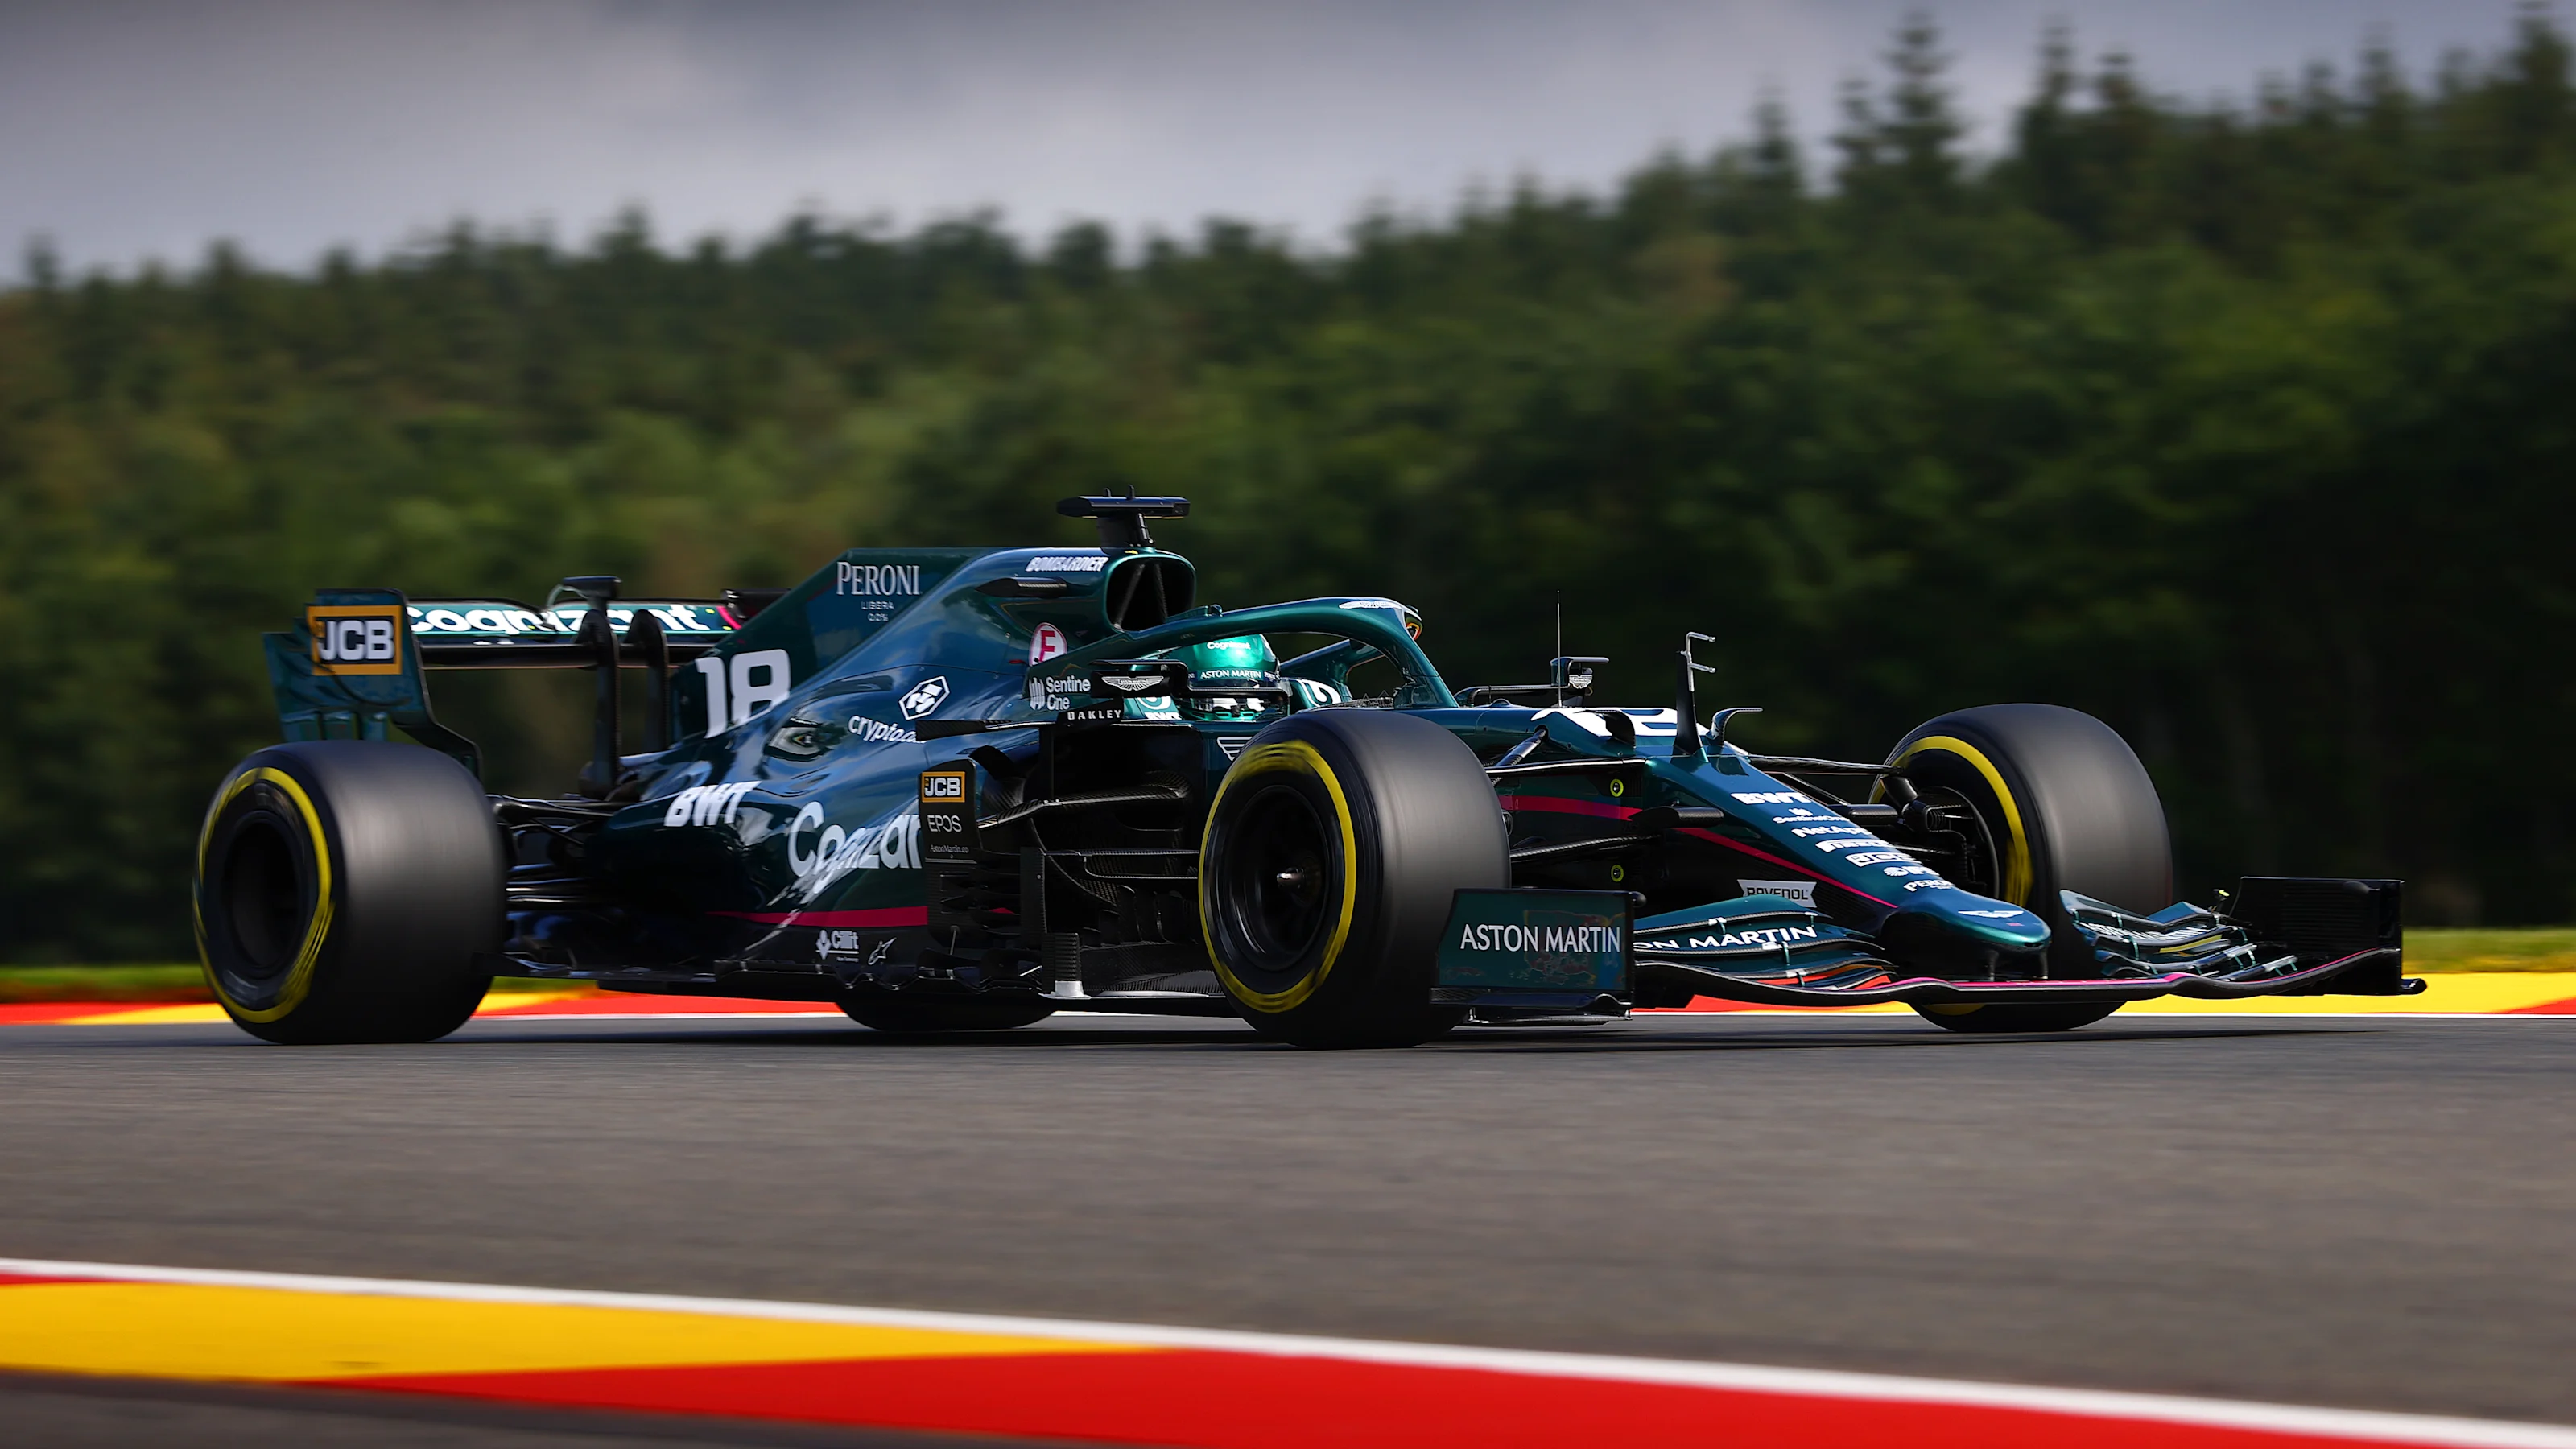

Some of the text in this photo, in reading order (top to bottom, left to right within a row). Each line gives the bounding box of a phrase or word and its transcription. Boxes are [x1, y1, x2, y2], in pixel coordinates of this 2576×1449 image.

[836, 561, 920, 595] PERONI
[861, 601, 895, 610] LIBERA
[317, 620, 395, 660] JCB
[1200, 670, 1230, 679] ASTON
[1231, 669, 1262, 679] MARTIN
[694, 649, 791, 739] 18
[1046, 675, 1092, 694] Sentine
[1046, 694, 1071, 711] One
[1067, 709, 1122, 720] OAKLEY
[924, 777, 961, 797] JCB
[663, 780, 763, 828] BWT
[1731, 792, 1812, 805] BWT
[927, 815, 963, 833] EPOS
[1460, 923, 1620, 953] ASTON MARTIN
[1690, 926, 1818, 949] MARTIN
